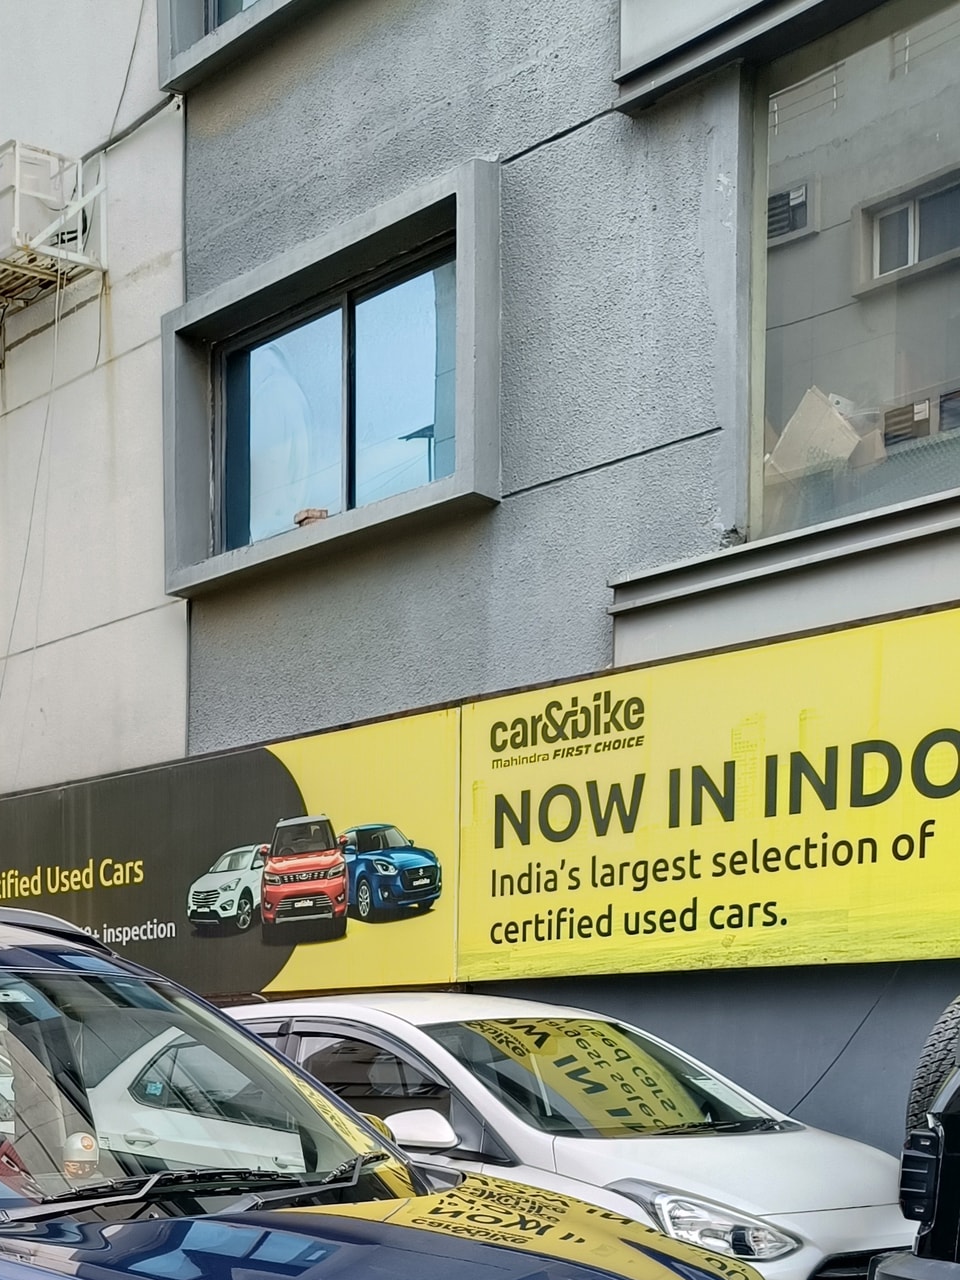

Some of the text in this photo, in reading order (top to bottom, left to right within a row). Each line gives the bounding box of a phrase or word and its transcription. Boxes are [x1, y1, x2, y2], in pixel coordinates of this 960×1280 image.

[490, 690, 645, 752] car&bike
[491, 735, 645, 769] Mahindra FIRST CHOICE
[493, 727, 960, 849] NOW IN INDO
[46, 858, 94, 894] Used
[99, 858, 144, 887] Cars
[591, 848, 701, 892] largest
[711, 832, 878, 878] selection
[892, 820, 936, 861] of
[103, 918, 176, 946] inspection
[489, 897, 788, 945] certified used cars.
